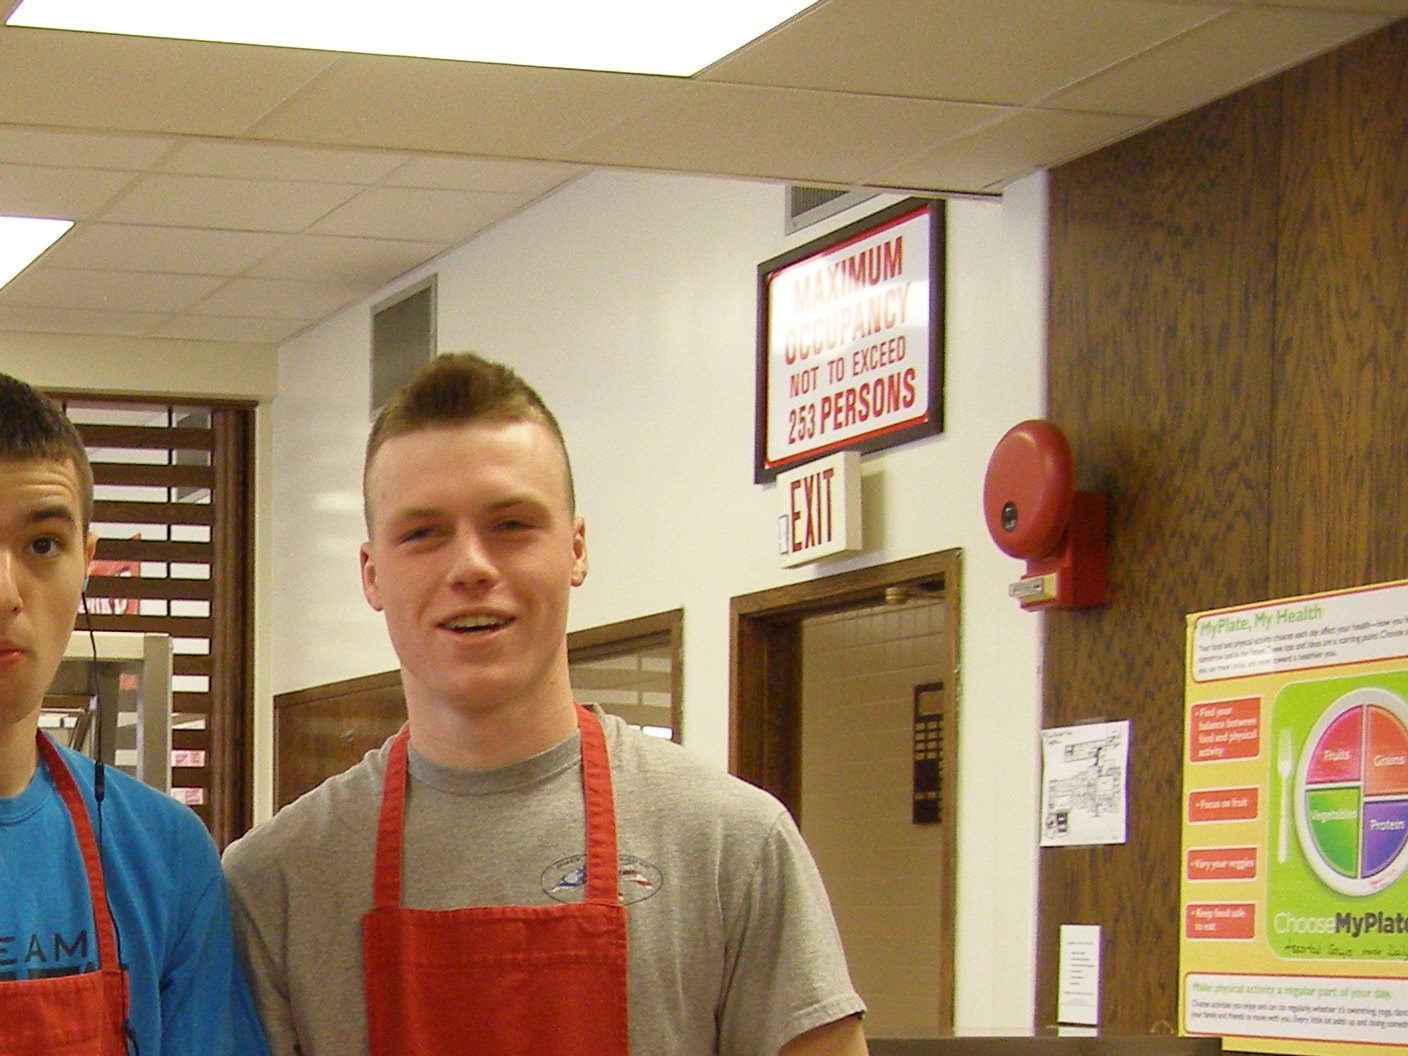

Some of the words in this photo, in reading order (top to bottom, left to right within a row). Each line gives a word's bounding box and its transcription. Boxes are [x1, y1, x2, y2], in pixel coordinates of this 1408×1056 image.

[794, 236, 903, 311] MAXIMUM
[785, 282, 910, 365] OCCUPANCY
[790, 366, 819, 399] NOT
[827, 356, 844, 385] TO
[852, 335, 906, 376] EXCEED
[788, 402, 815, 445] 253
[820, 367, 916, 435] PERSONS
[790, 467, 834, 552] EXIT
[1254, 611, 1273, 631] My
[1276, 604, 1323, 625] Health
[1369, 819, 1405, 831] Protein
